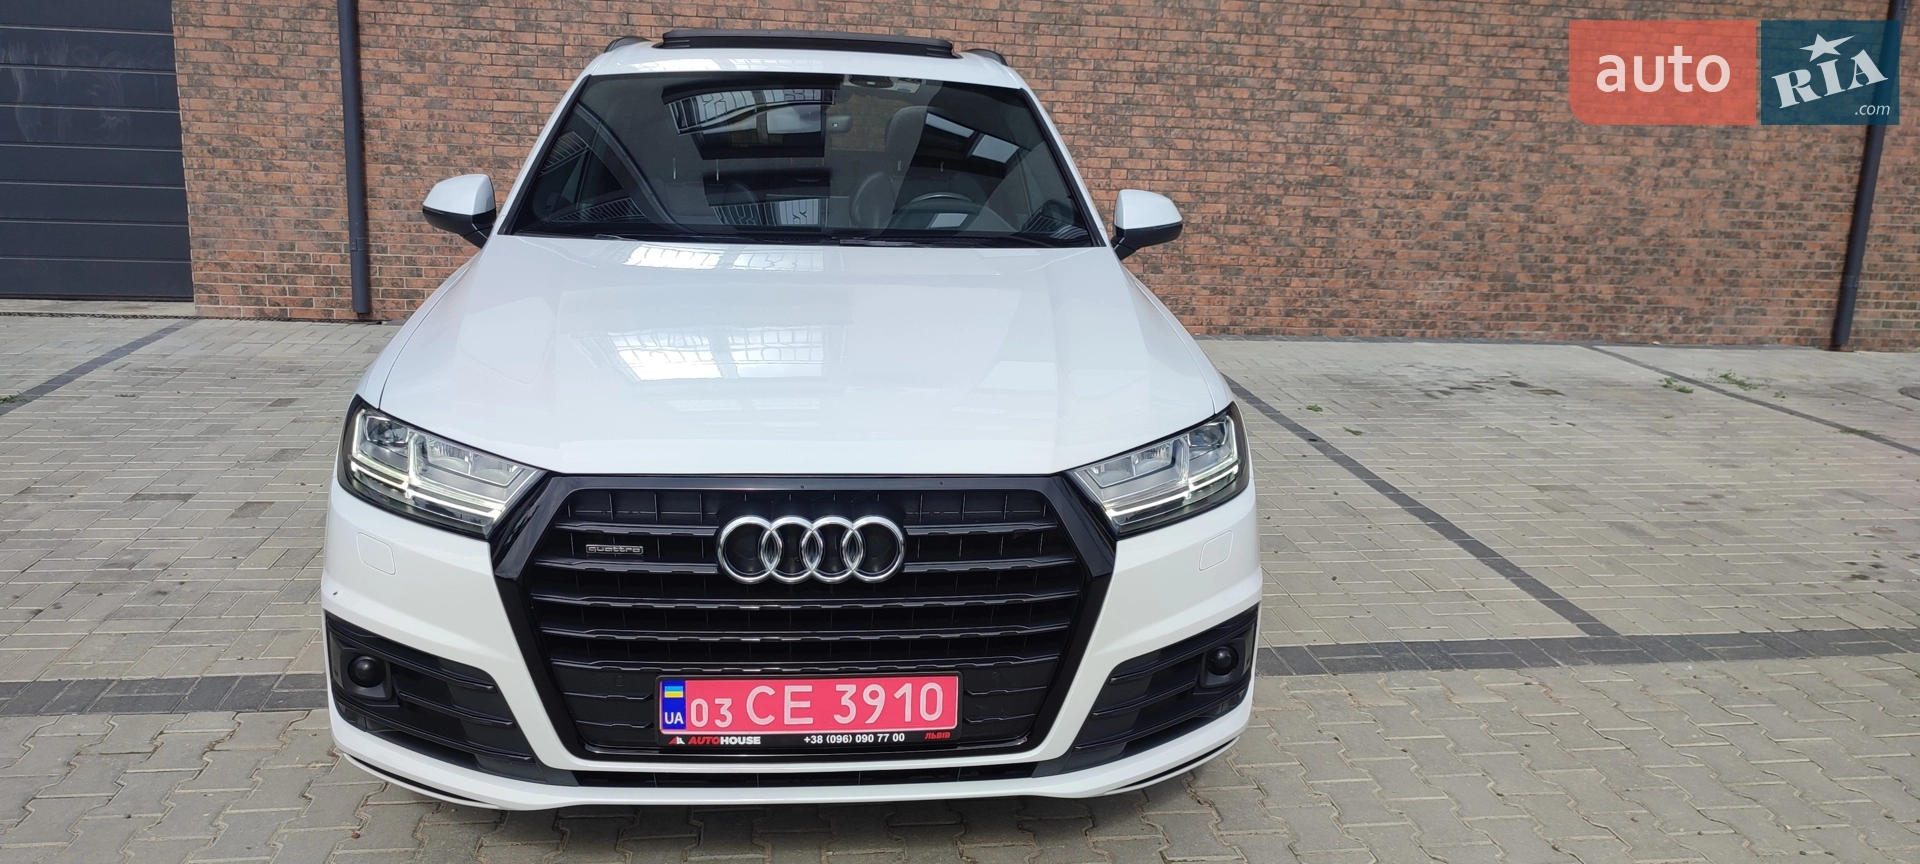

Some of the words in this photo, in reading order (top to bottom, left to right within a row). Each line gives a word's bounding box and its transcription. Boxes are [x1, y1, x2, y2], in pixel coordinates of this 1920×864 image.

[690, 698, 733, 728] 03
[746, 685, 814, 726] CE
[833, 682, 944, 724] 3910
[664, 712, 684, 725] UA
[688, 736, 761, 745] AUTOHOUSE
[803, 736, 823, 744] +38
[826, 735, 852, 745] (096)
[855, 734, 874, 743] 090
[877, 734, 890, 742] 77
[892, 733, 905, 742] 00
